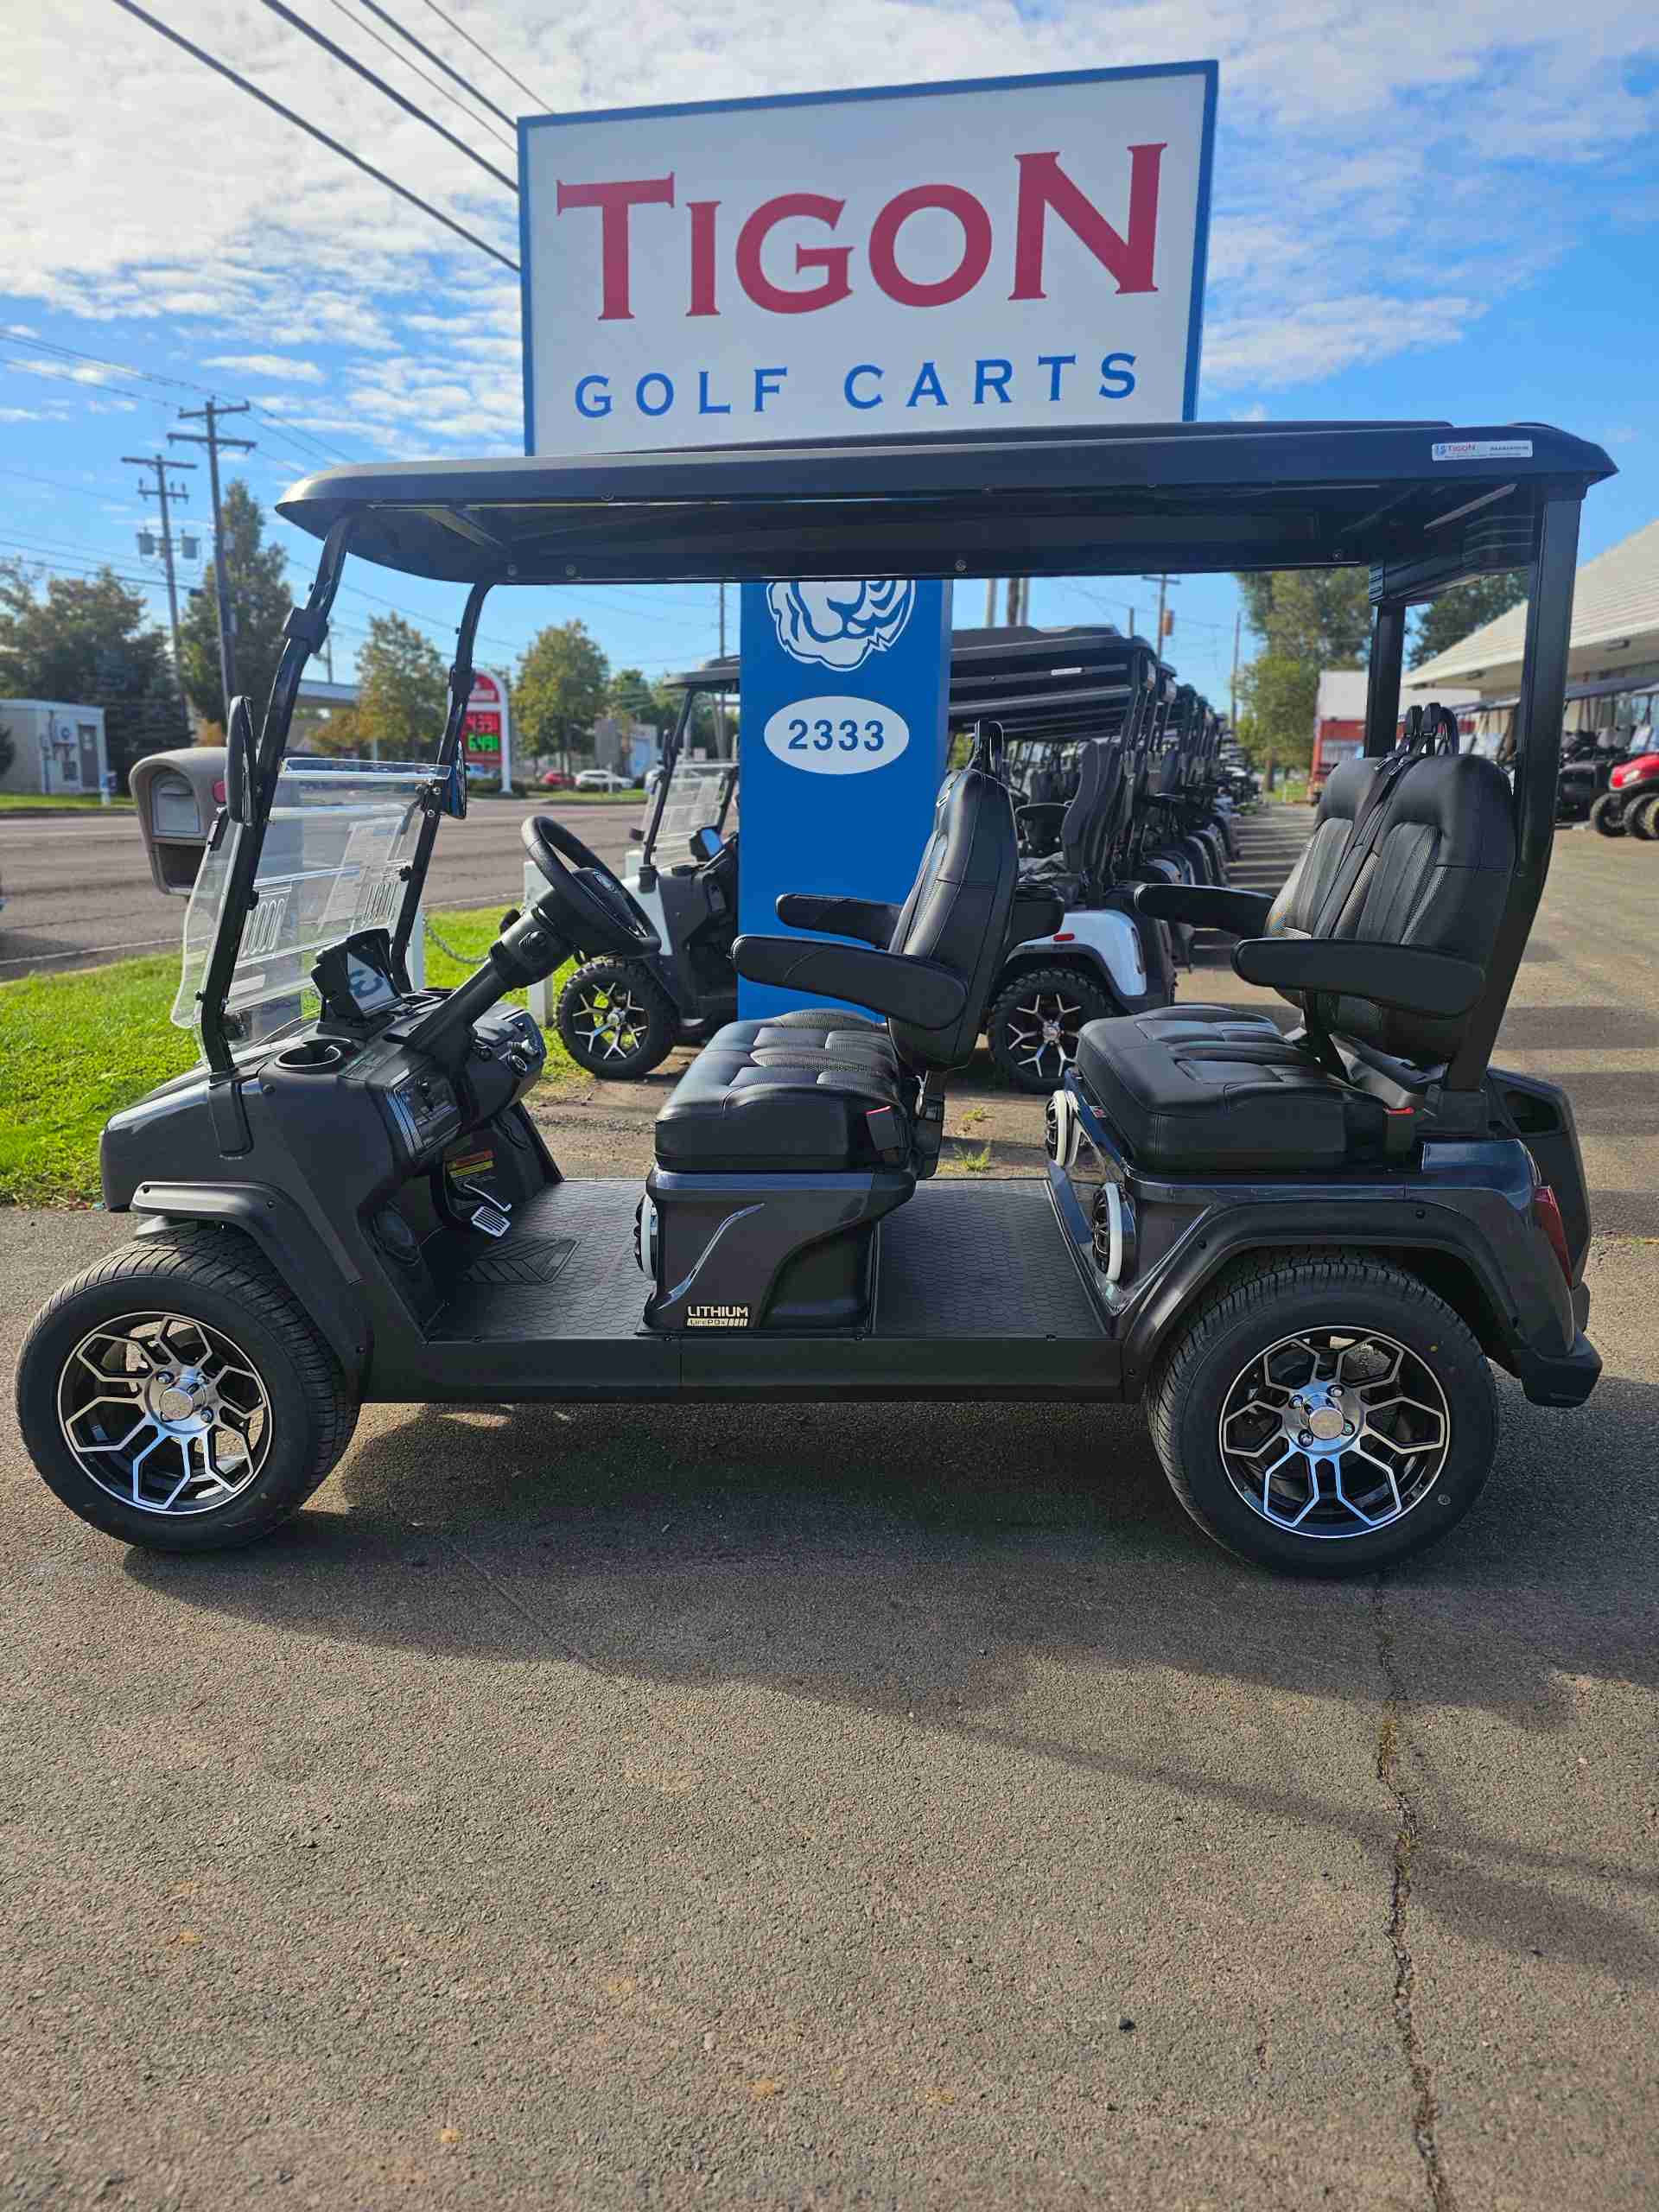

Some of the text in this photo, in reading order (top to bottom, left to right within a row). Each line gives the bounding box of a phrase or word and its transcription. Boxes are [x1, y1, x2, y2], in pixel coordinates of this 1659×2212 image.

[556, 143, 1167, 321] TIGON
[575, 353, 1137, 418] GOLF CARTS
[787, 718, 885, 752] 2333
[687, 1306, 748, 1317] LITHIUM
